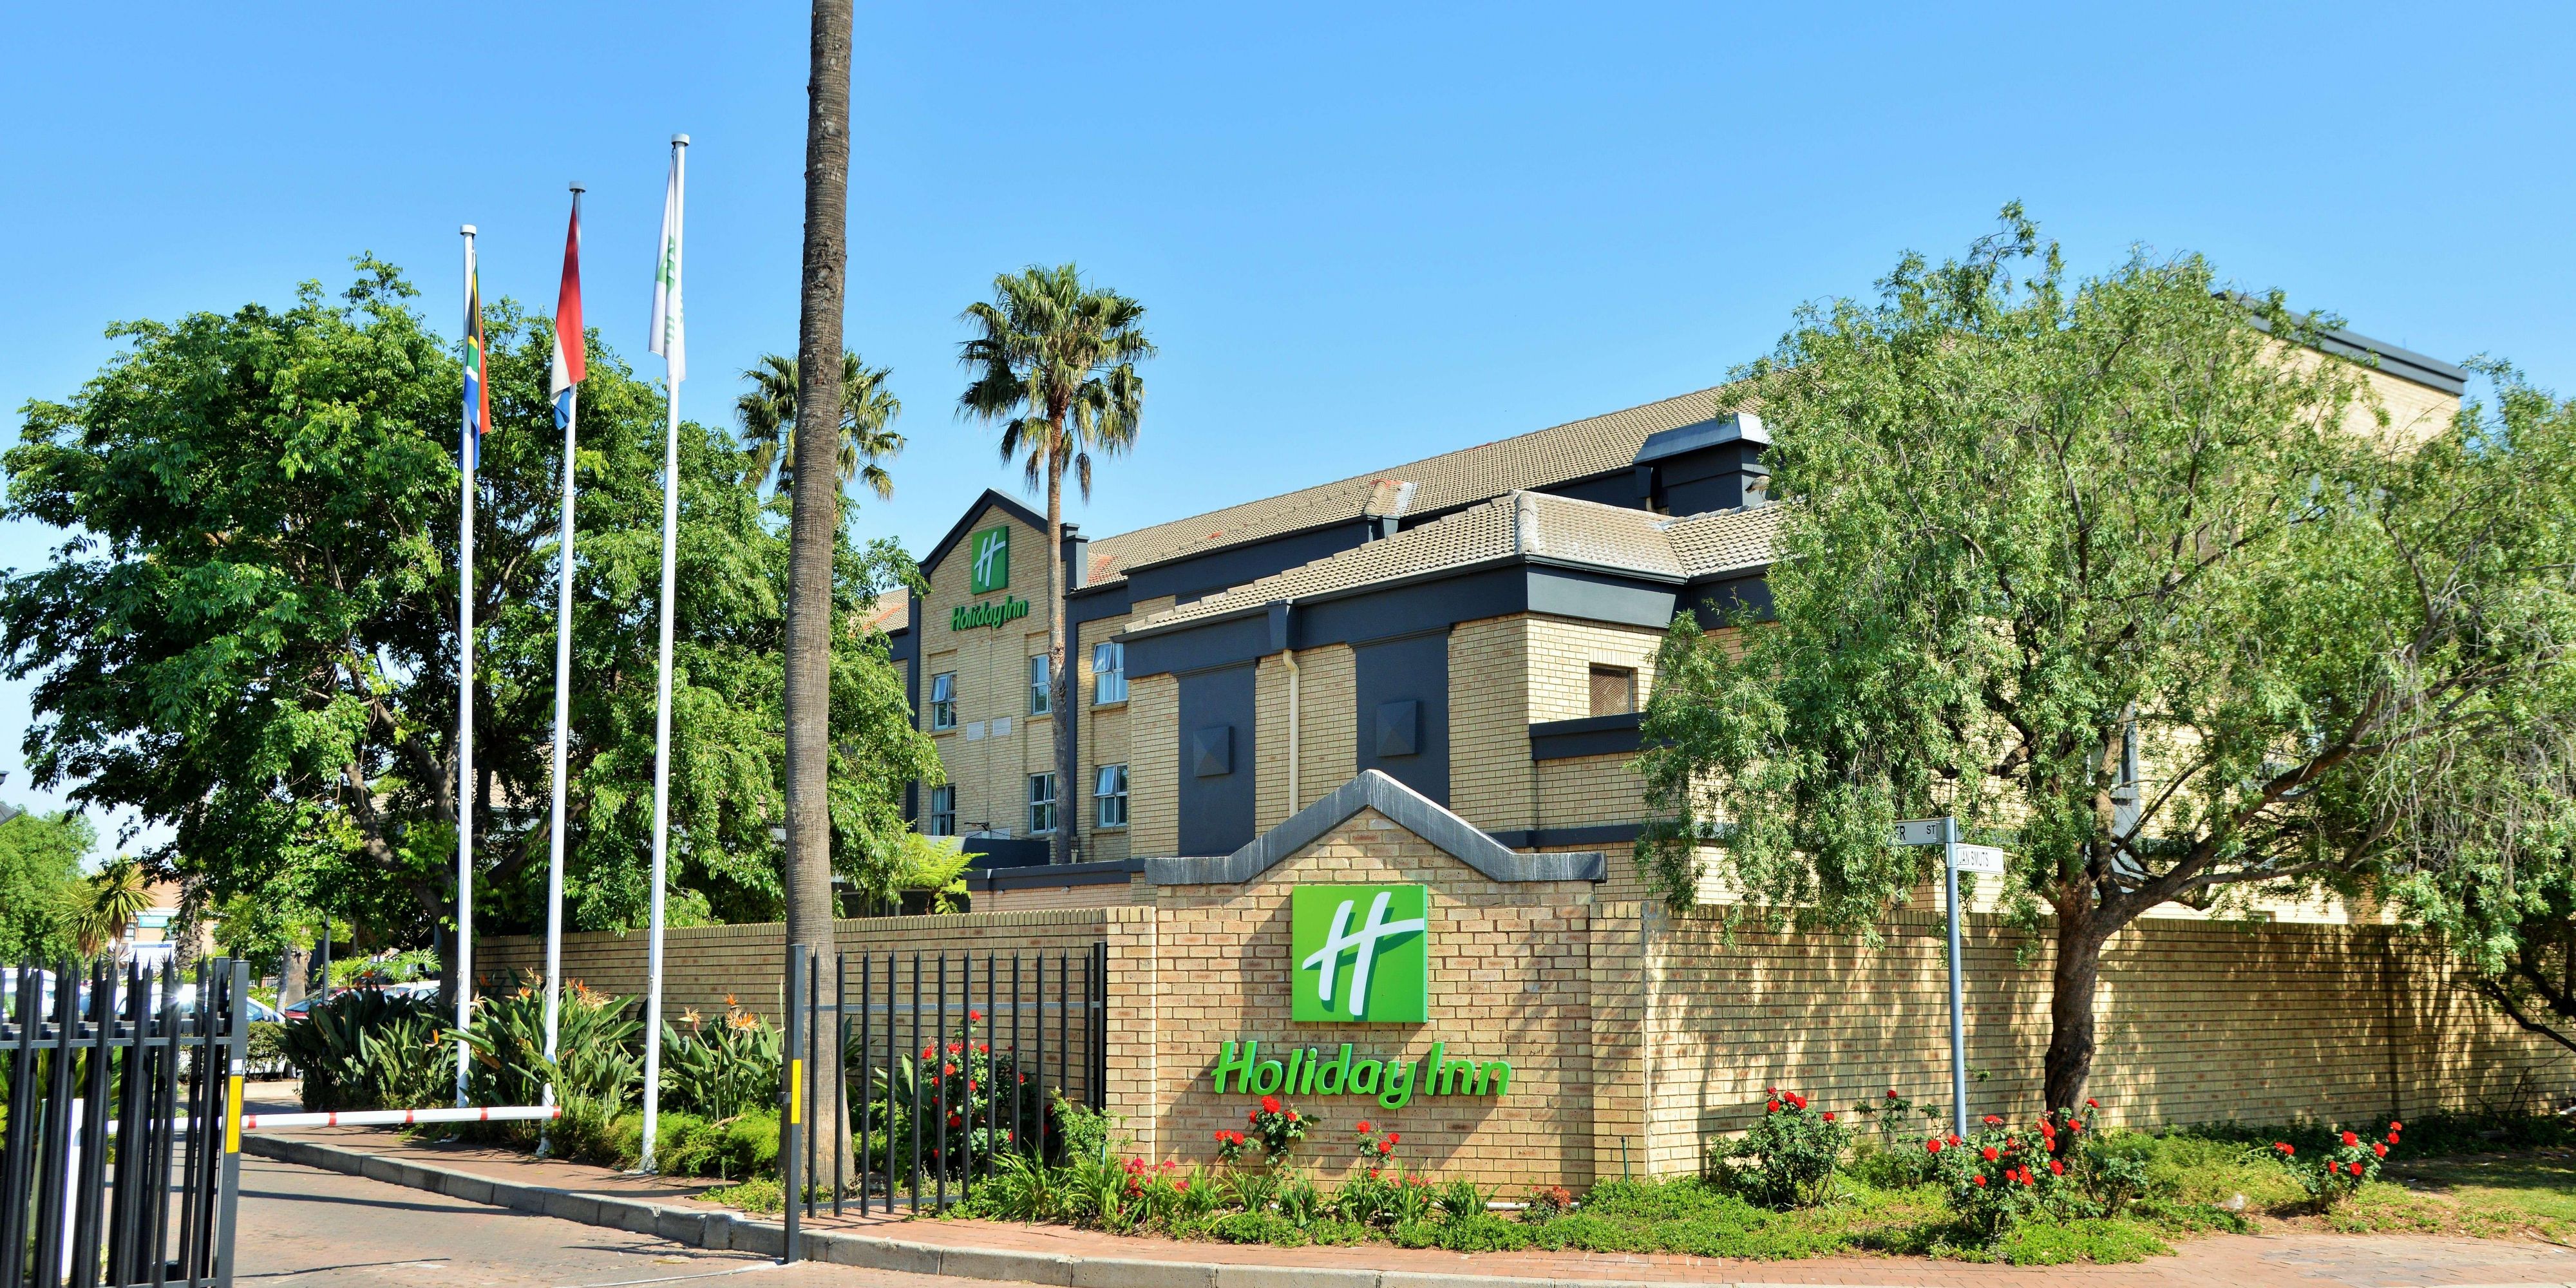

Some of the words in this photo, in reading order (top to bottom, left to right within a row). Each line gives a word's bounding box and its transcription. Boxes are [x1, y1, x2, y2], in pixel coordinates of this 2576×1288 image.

[951, 600, 1005, 631] Holiday
[1004, 595, 1029, 620] Inn
[1926, 825, 1936, 835] ST
[1959, 849, 1969, 864] JAN
[1971, 850, 1989, 867] SMUTS
[1211, 1039, 1417, 1110] Holiday
[1425, 1041, 1512, 1097] Inn
